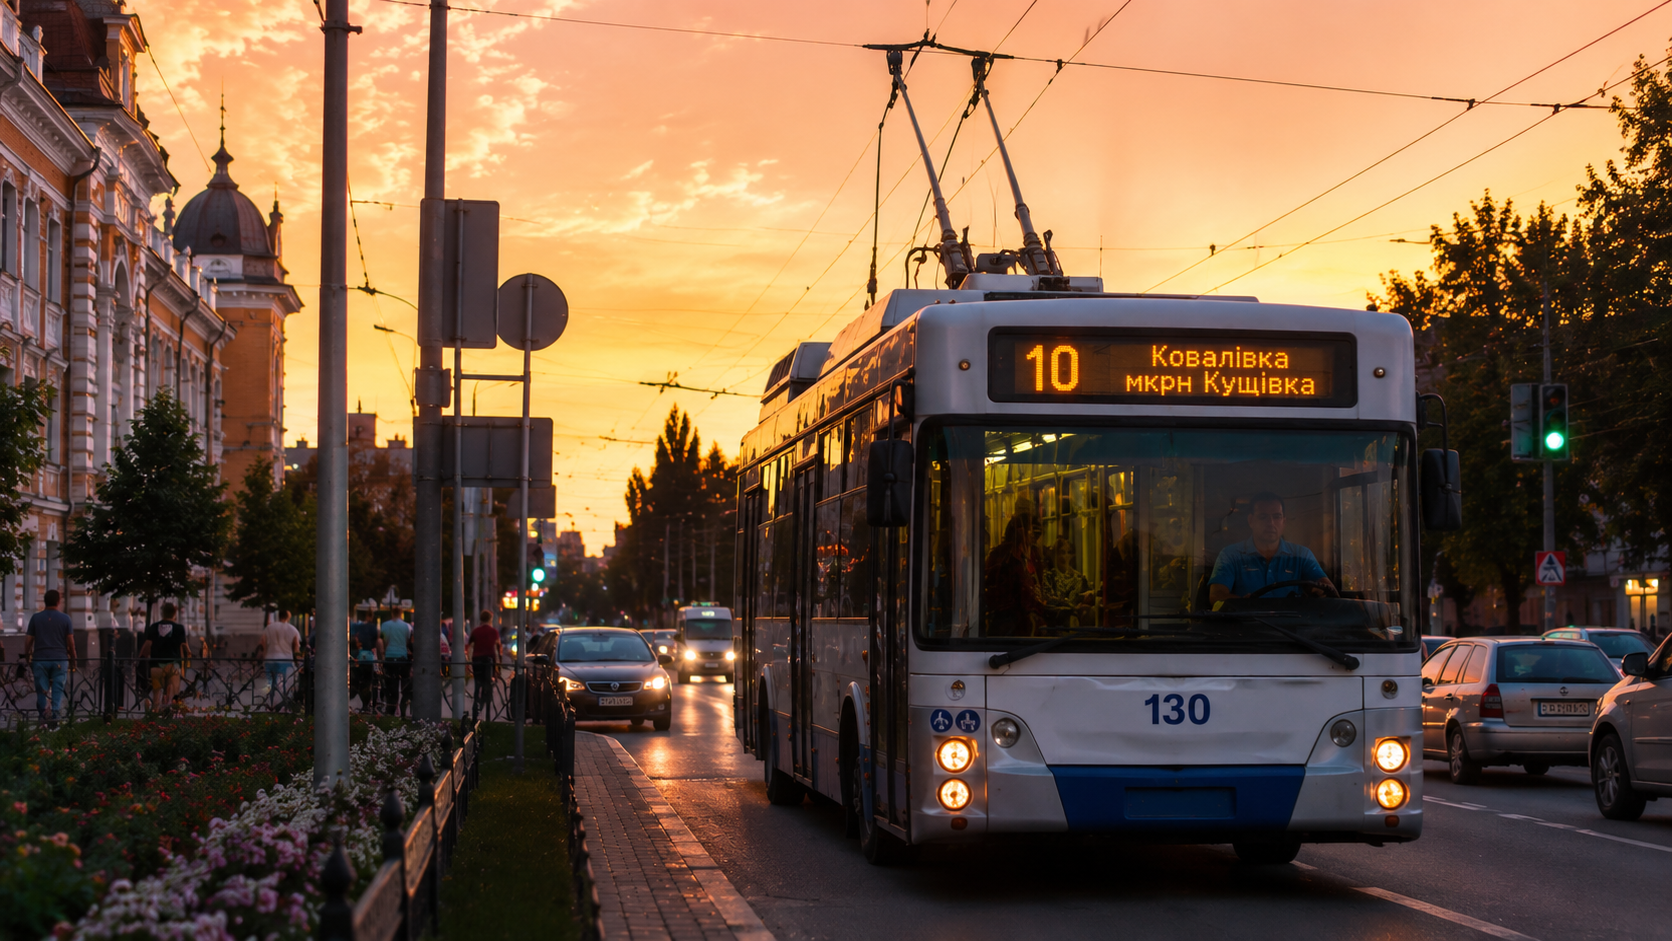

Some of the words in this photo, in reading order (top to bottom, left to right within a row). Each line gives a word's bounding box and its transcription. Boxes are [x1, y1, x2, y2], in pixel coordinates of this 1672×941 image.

[1025, 345, 1080, 392] 10
[1151, 345, 1290, 369] Ковалівка
[1126, 374, 1192, 396] мкрн
[1204, 371, 1316, 396] Кущівка
[1145, 693, 1211, 726] 130
